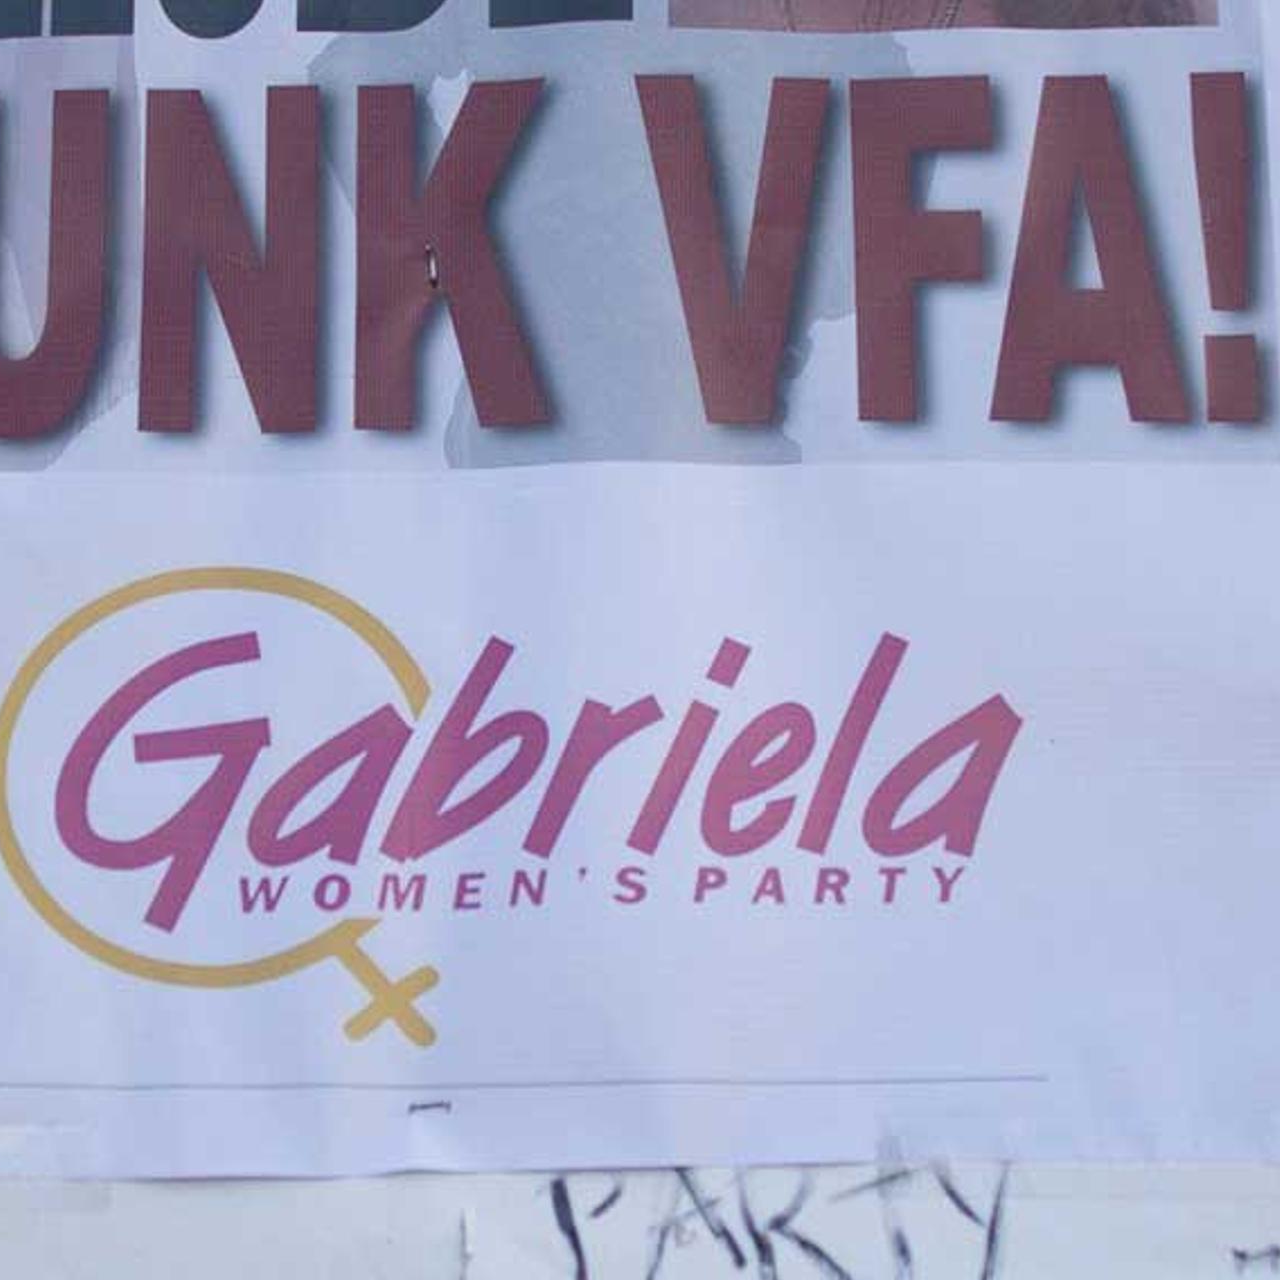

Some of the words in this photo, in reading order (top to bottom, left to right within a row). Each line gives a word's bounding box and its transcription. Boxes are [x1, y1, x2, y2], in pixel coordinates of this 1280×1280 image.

[635, 71, 1261, 425] VFA!
[54, 631, 1023, 933] Gabriela
[238, 866, 648, 914] WOMEN'S
[692, 866, 965, 906] PARTY
